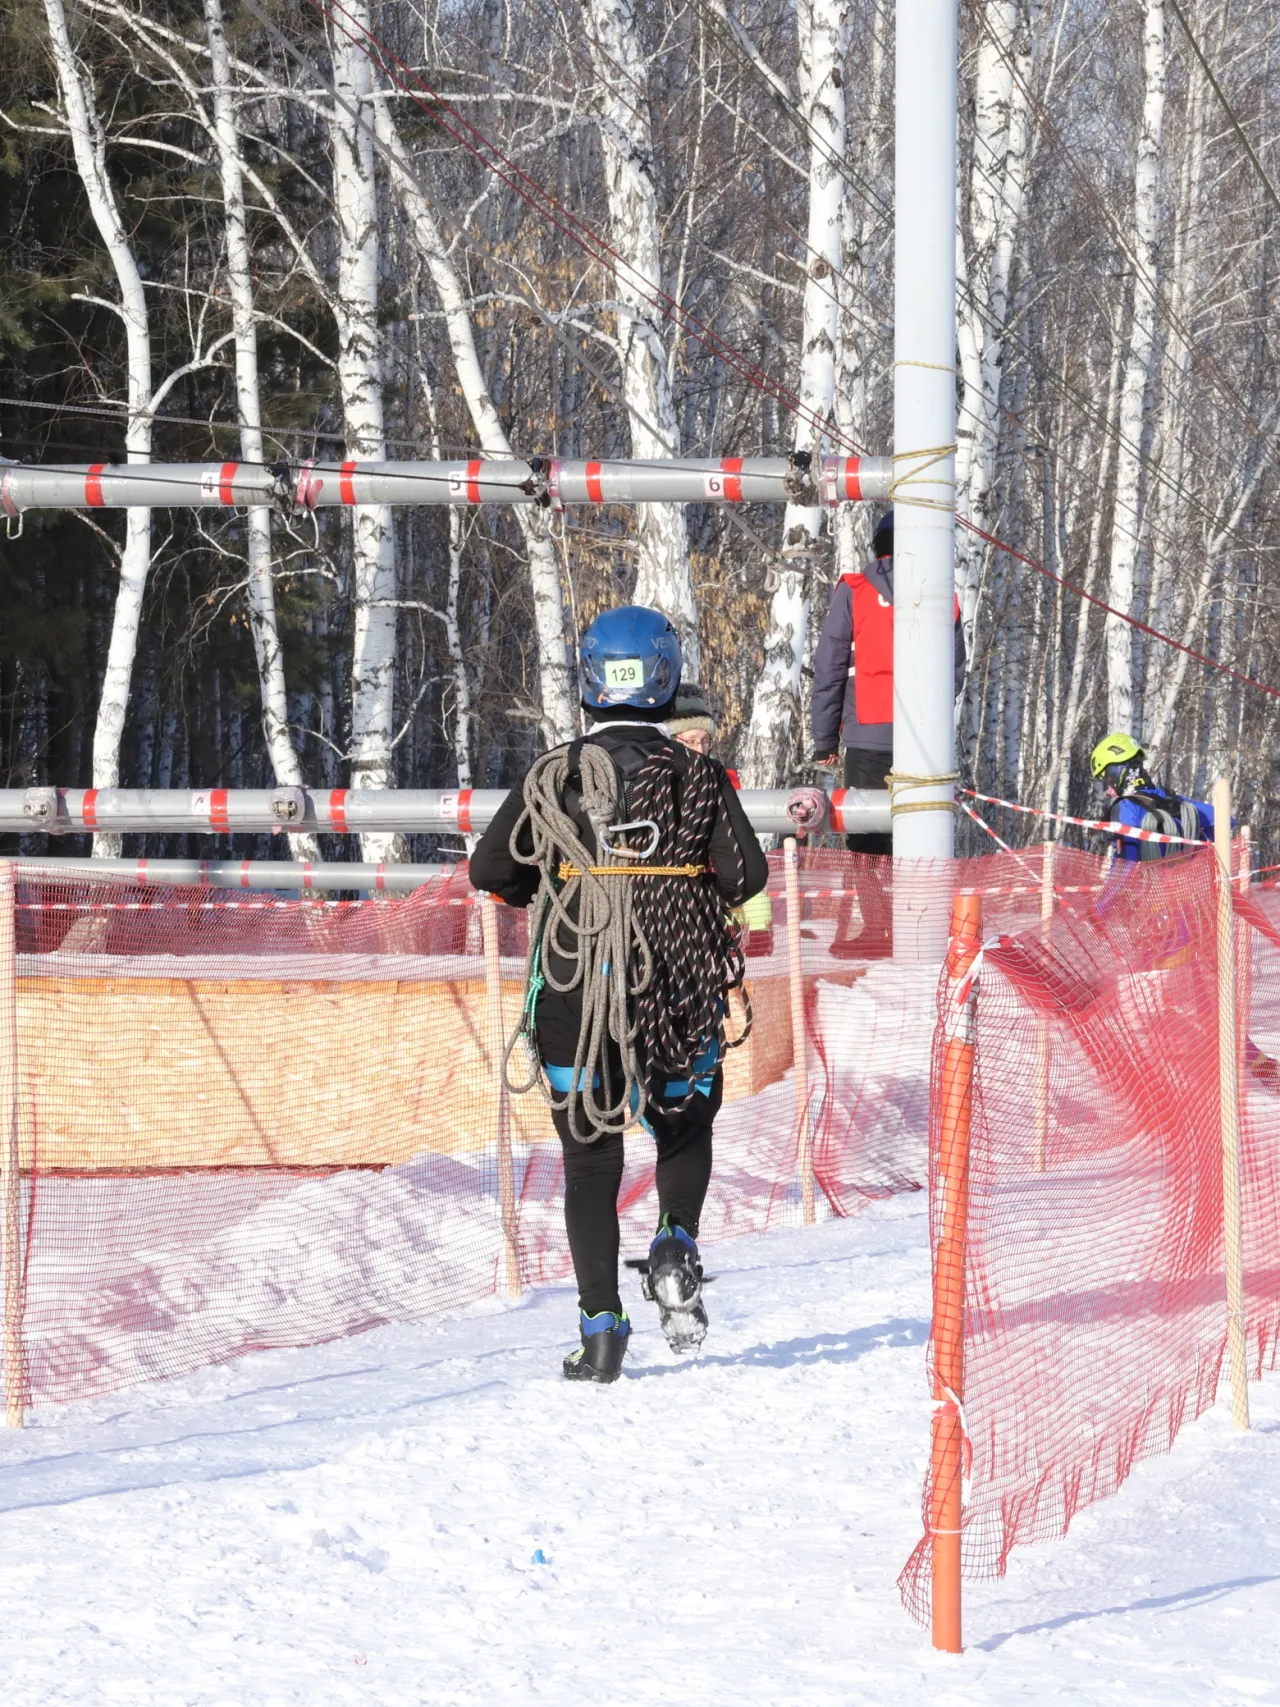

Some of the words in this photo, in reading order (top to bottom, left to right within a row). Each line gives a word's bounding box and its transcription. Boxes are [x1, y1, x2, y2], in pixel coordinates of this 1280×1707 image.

[202, 476, 214, 493] 4
[451, 474, 461, 491] 5
[709, 476, 720, 492] 6
[611, 666, 636, 682] 129
